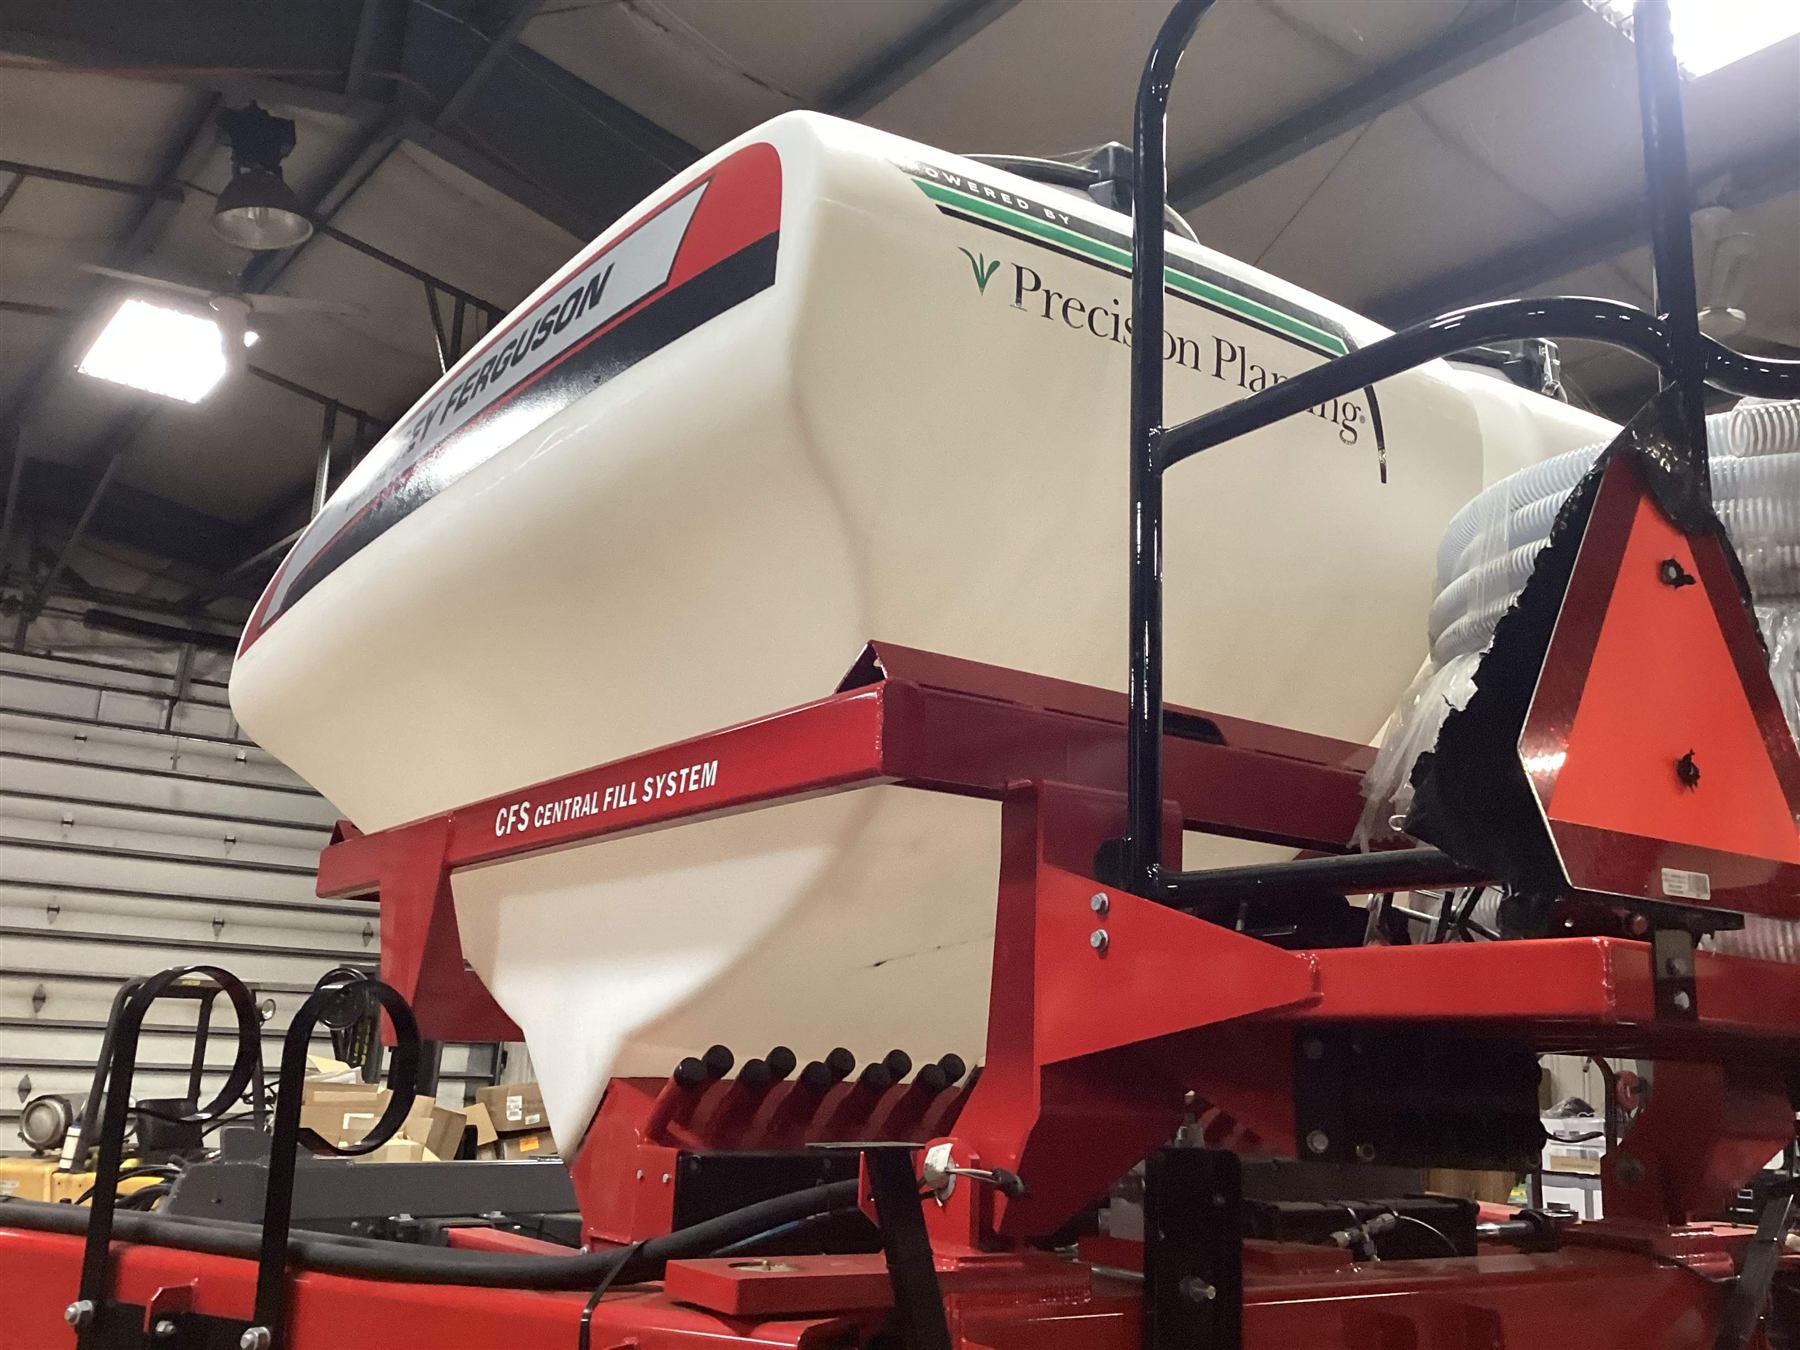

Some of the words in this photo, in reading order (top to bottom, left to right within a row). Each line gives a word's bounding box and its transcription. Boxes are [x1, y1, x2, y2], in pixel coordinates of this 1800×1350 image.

[1043, 207, 1070, 225] BY
[439, 261, 615, 426] FERGUSON
[495, 801, 531, 837] CFS
[534, 791, 599, 828] CENTRAL
[603, 781, 637, 812] FILL
[642, 760, 718, 802] SYSTEM
